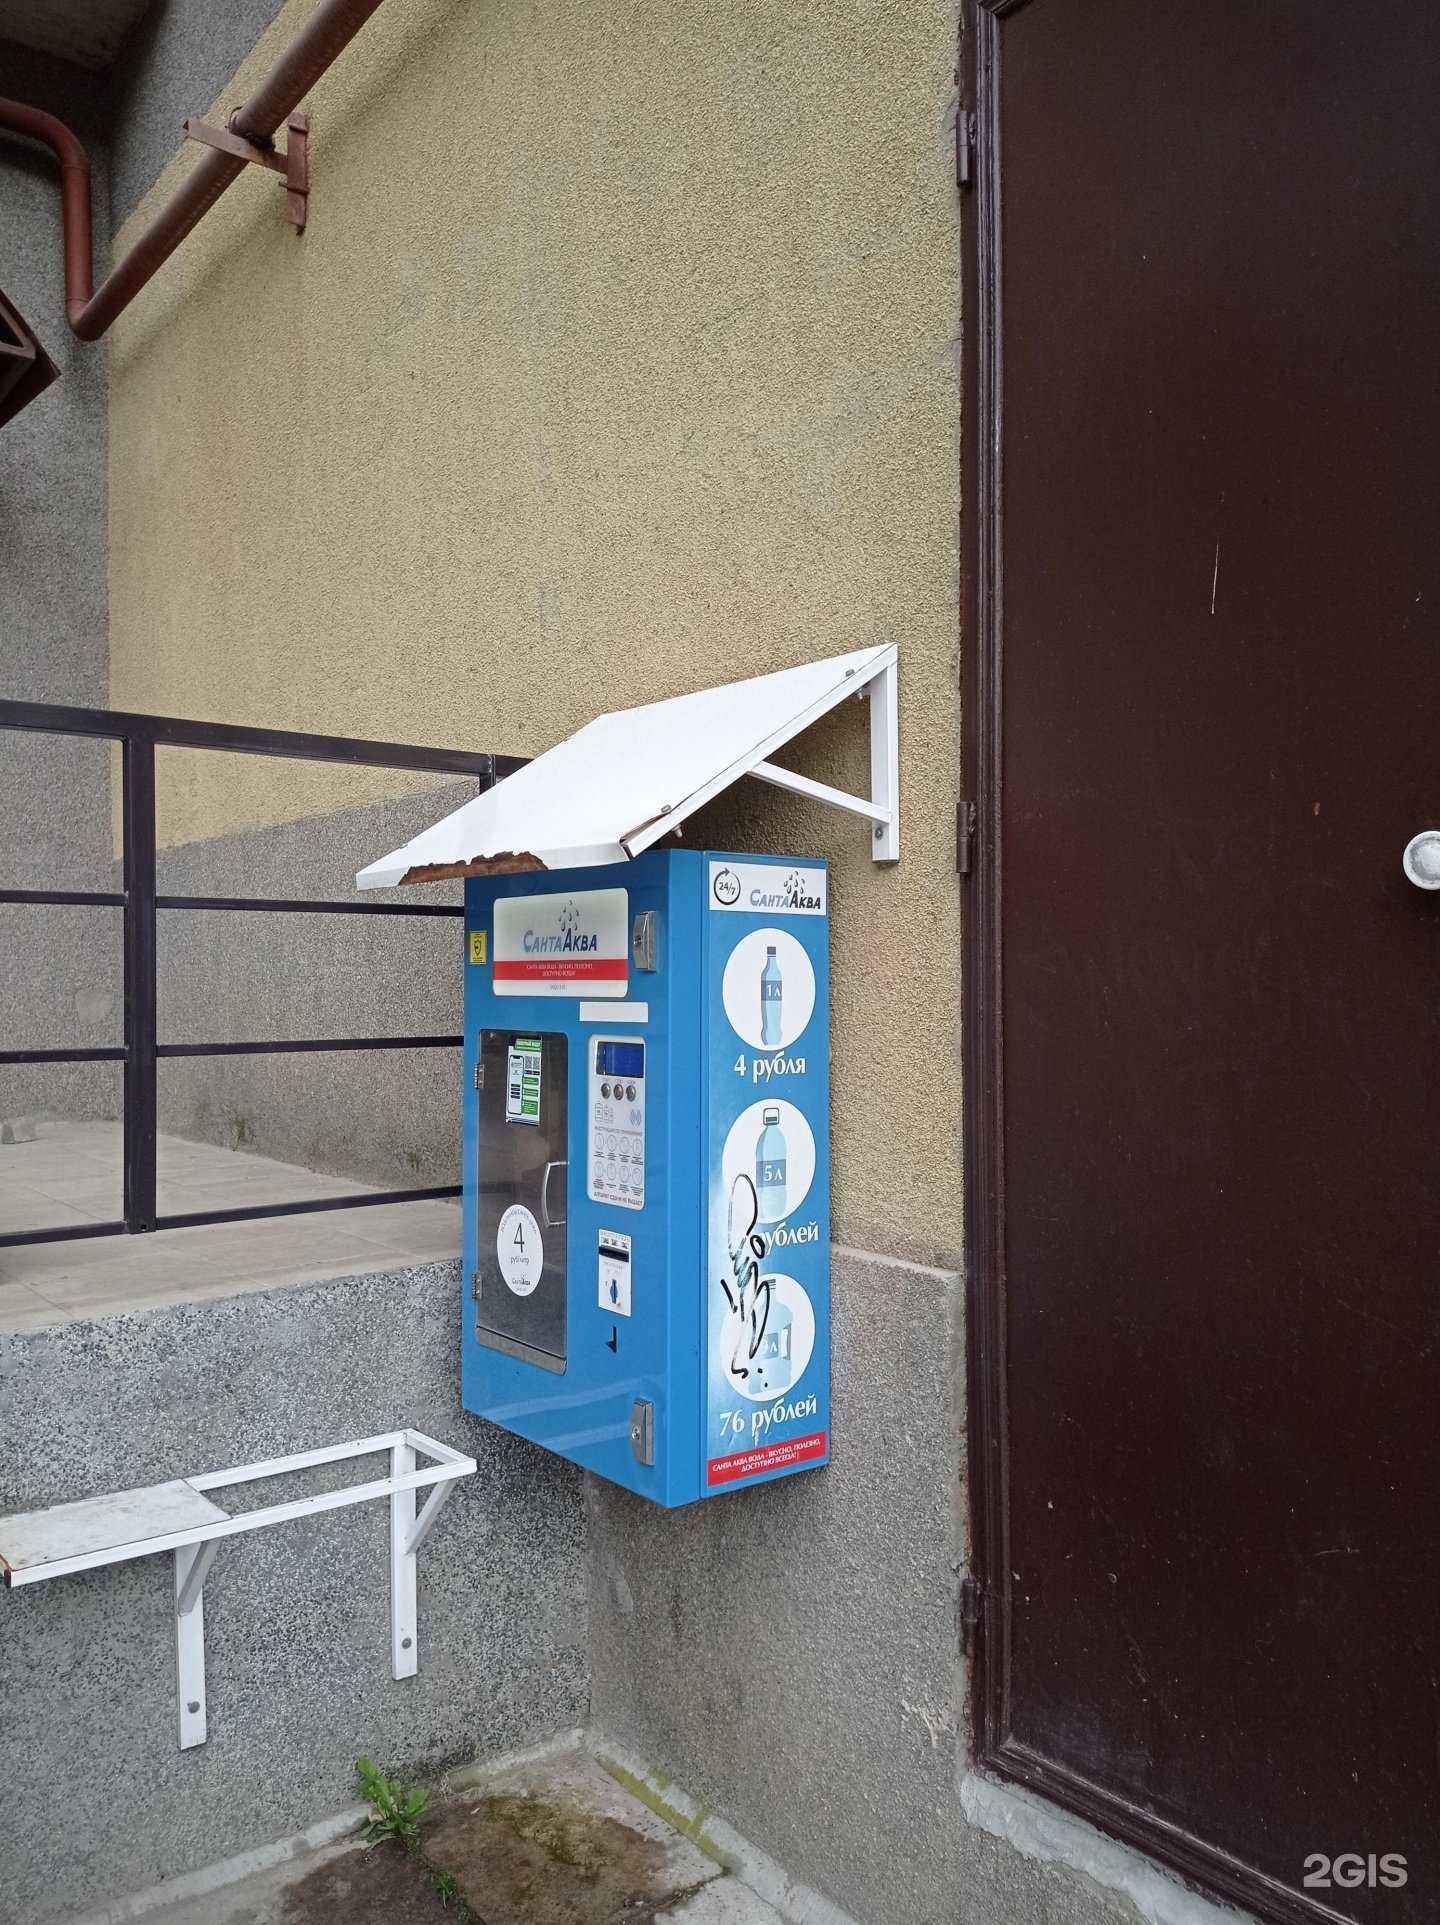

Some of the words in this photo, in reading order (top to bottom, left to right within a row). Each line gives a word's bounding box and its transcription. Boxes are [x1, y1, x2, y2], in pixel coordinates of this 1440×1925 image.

[718, 881, 736, 897] 24/7
[734, 1054, 747, 1077] 4
[752, 1050, 807, 1084] рубля
[513, 1222, 525, 1254] 4
[757, 1221, 819, 1255] ублей
[720, 1409, 745, 1437] 76
[751, 1392, 817, 1438] рублей
[712, 1461, 732, 1472] САНТА
